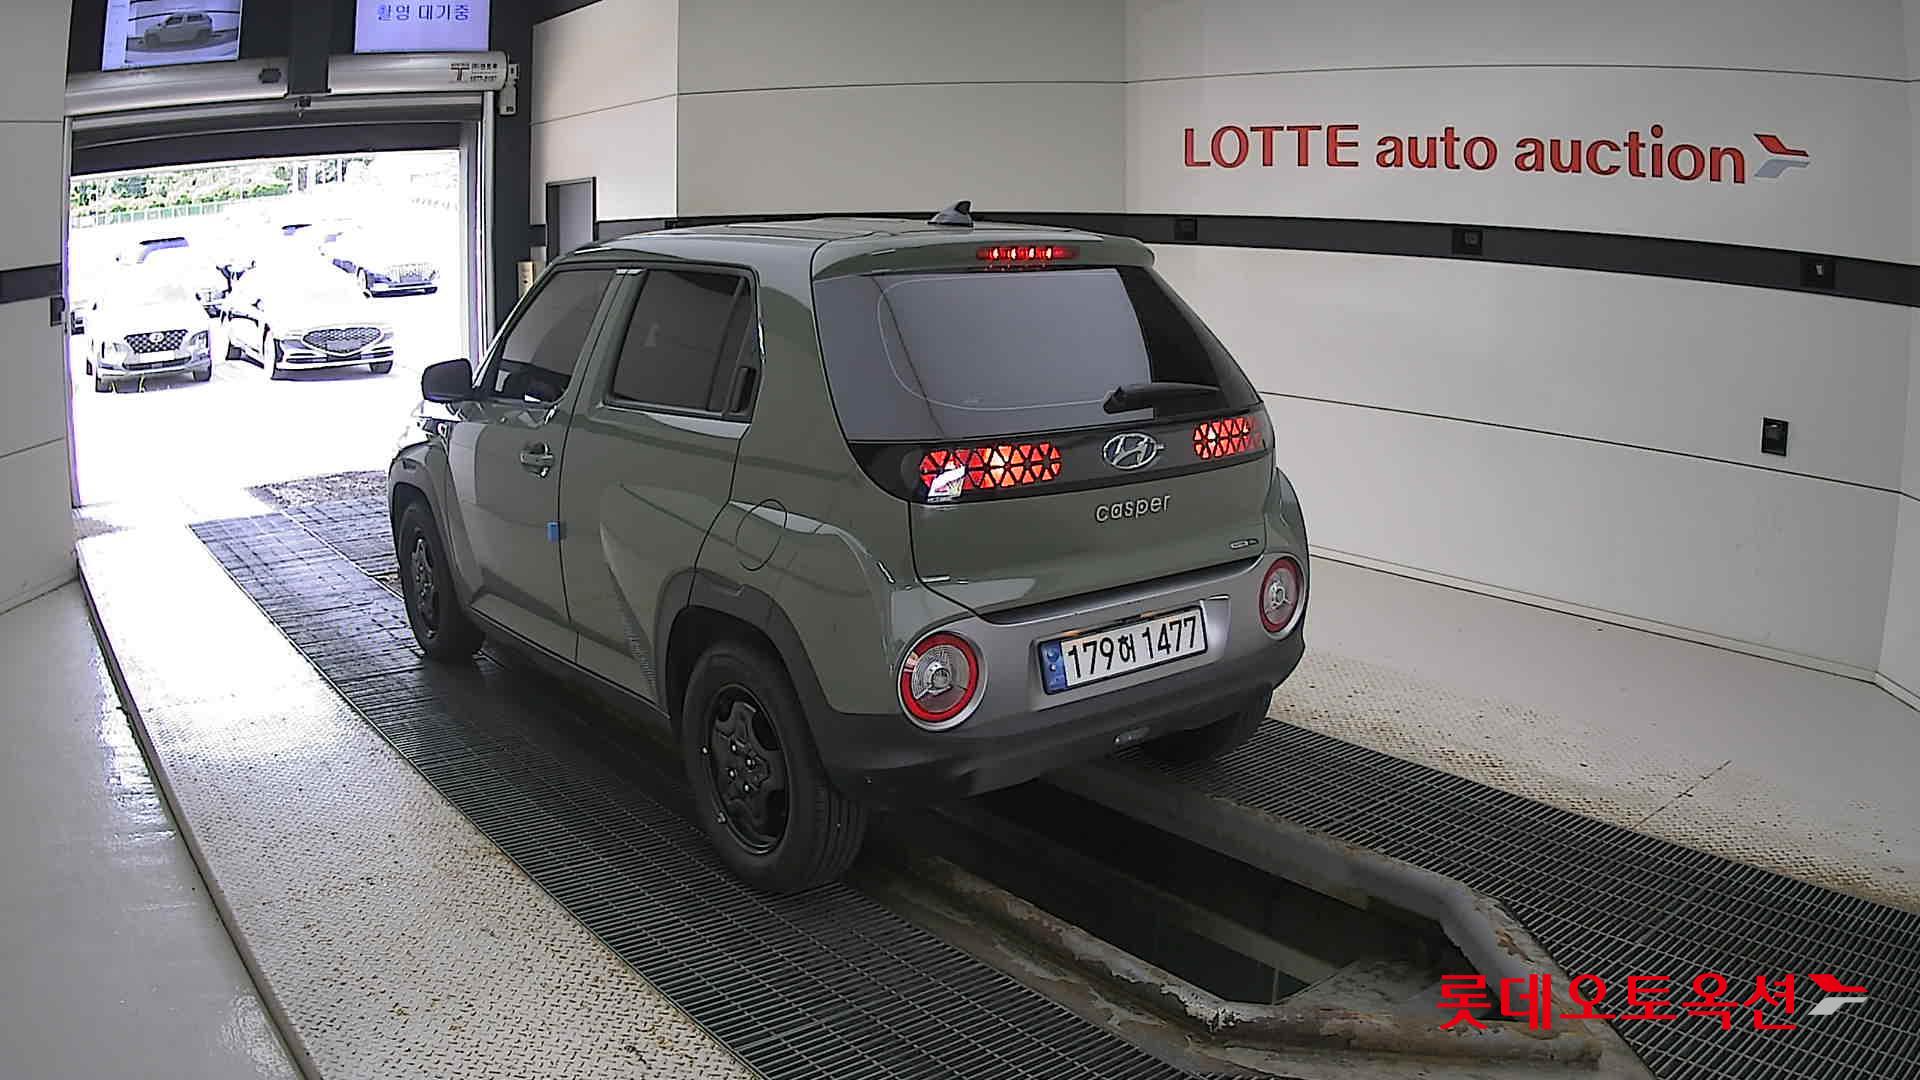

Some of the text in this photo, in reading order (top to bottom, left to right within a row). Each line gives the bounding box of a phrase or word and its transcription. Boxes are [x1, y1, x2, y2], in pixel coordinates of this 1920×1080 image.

[418, 4, 470, 21] 대기중
[1184, 124, 1746, 184] LOTTE auto auction
[1095, 495, 1172, 523] casper
[1067, 615, 1197, 679] 179허 1477
